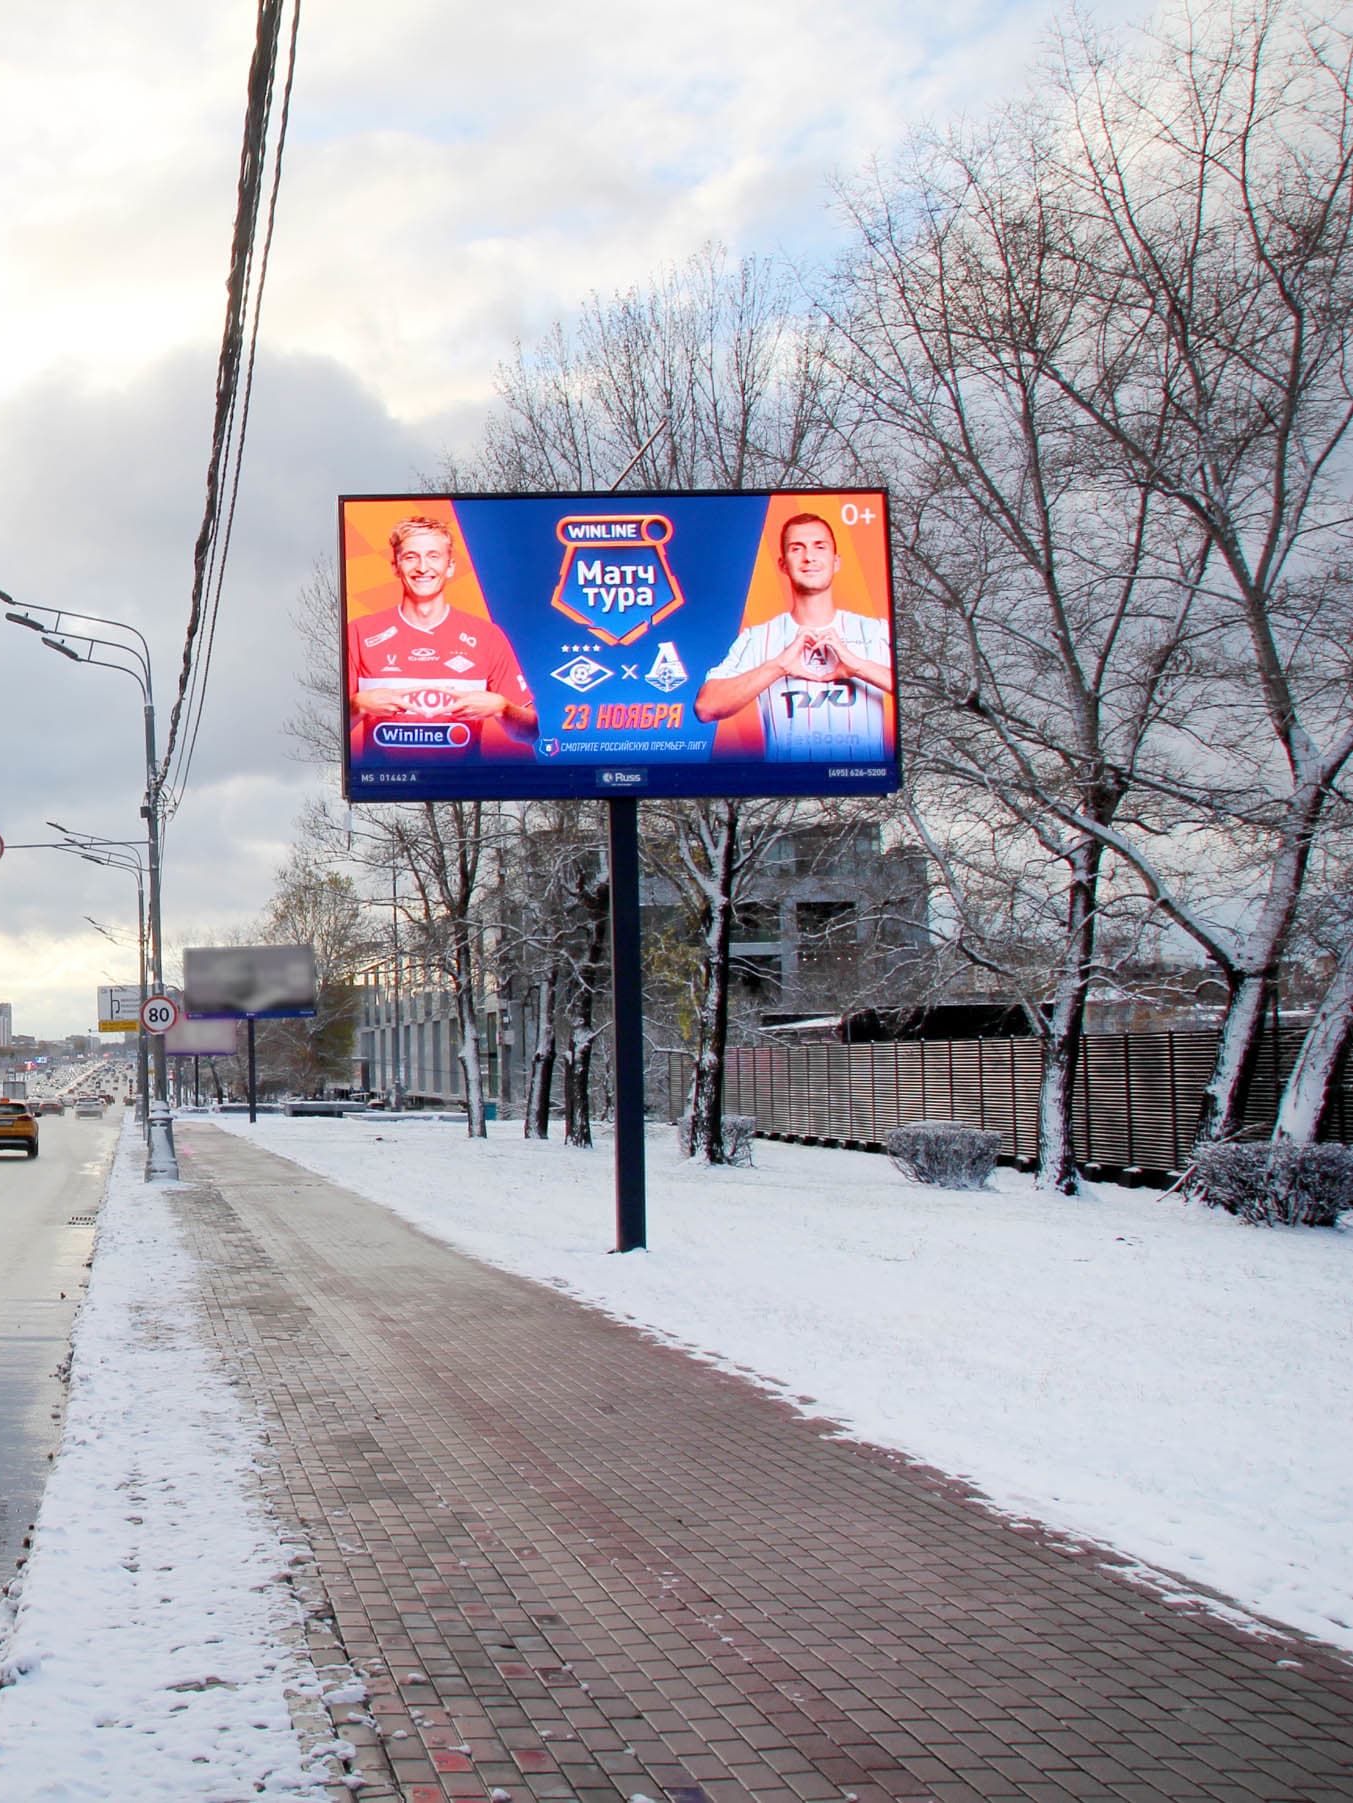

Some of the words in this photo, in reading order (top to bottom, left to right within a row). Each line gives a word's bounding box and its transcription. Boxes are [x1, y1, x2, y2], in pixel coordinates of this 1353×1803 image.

[841, 503, 877, 526] 0+
[567, 524, 638, 538] WINLINE
[577, 560, 655, 586] Матч
[582, 586, 654, 612] тура
[562, 704, 590, 730] 23
[597, 703, 684, 730] НОЯБРЯ
[383, 728, 444, 742] Winline
[560, 742, 599, 752] СМОТРИТЕ
[599, 740, 649, 751] РОССИЙСКУЮ
[361, 774, 375, 783] MS
[615, 773, 641, 782] Russ
[148, 1007, 170, 1022] 80
